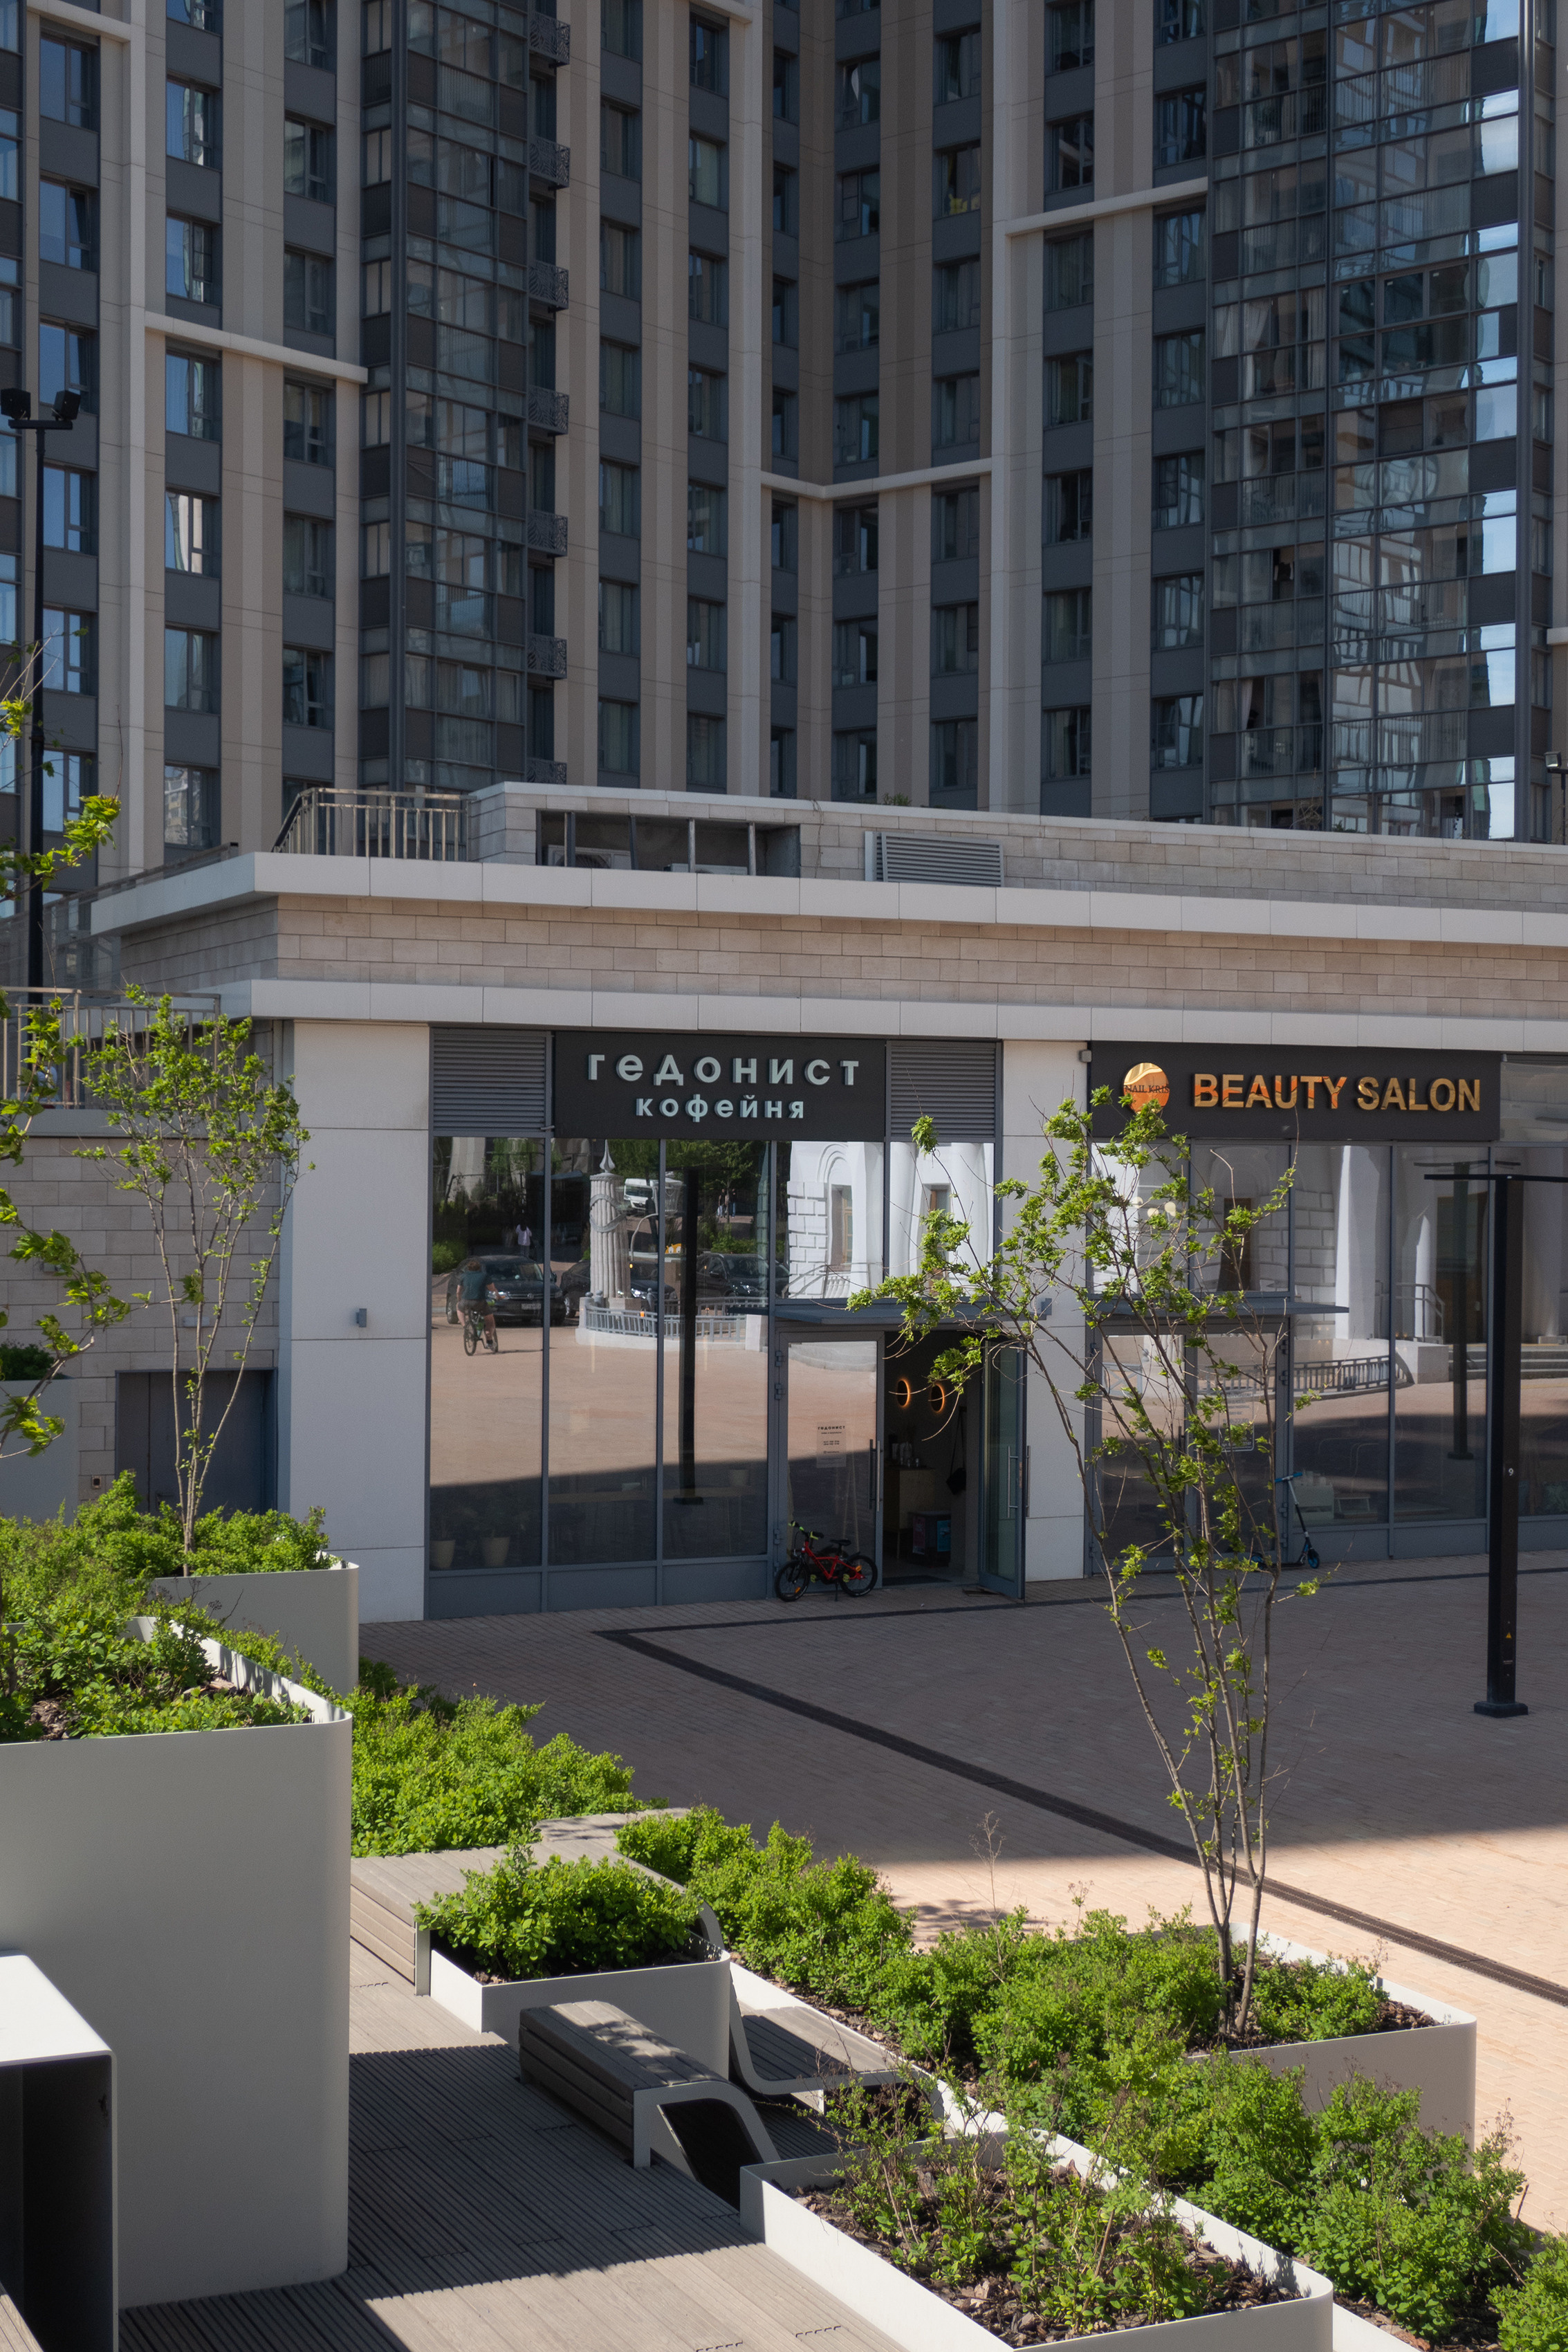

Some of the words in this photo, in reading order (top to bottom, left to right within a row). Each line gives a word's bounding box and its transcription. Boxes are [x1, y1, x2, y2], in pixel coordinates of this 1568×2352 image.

[1123, 1085, 1147, 1093] NAIL
[1148, 1084, 1170, 1093] KRIS
[1193, 1073, 1347, 1110] BEAUTY
[1356, 1076, 1481, 1112] SALON
[635, 1094, 804, 1123] кофейня
[1508, 1467, 1514, 1476] 9
